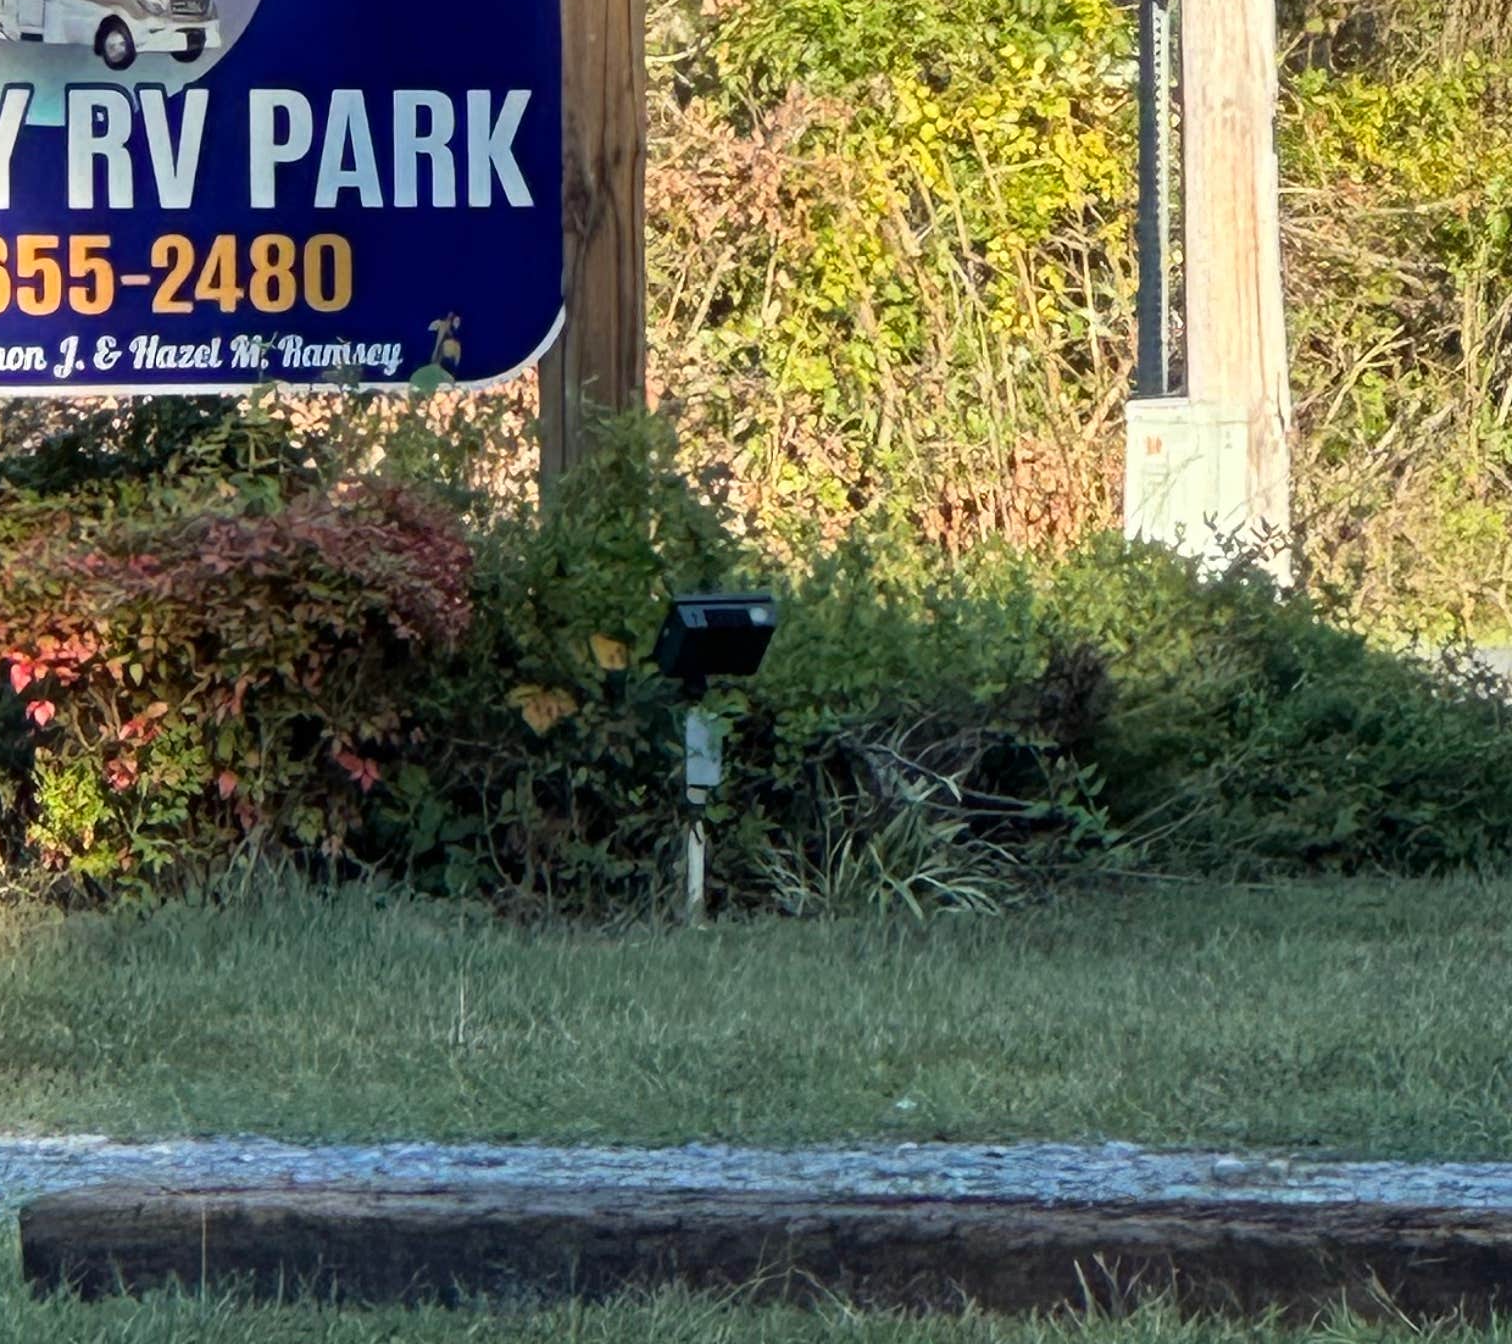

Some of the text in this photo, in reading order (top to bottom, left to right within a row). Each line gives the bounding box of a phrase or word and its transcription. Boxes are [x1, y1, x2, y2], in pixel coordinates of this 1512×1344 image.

[67, 88, 210, 210] RV
[249, 89, 535, 208] PARK
[53, 335, 85, 378] J.
[93, 335, 123, 371] &
[128, 335, 223, 369] Hazel
[277, 334, 404, 376] Ramsey
